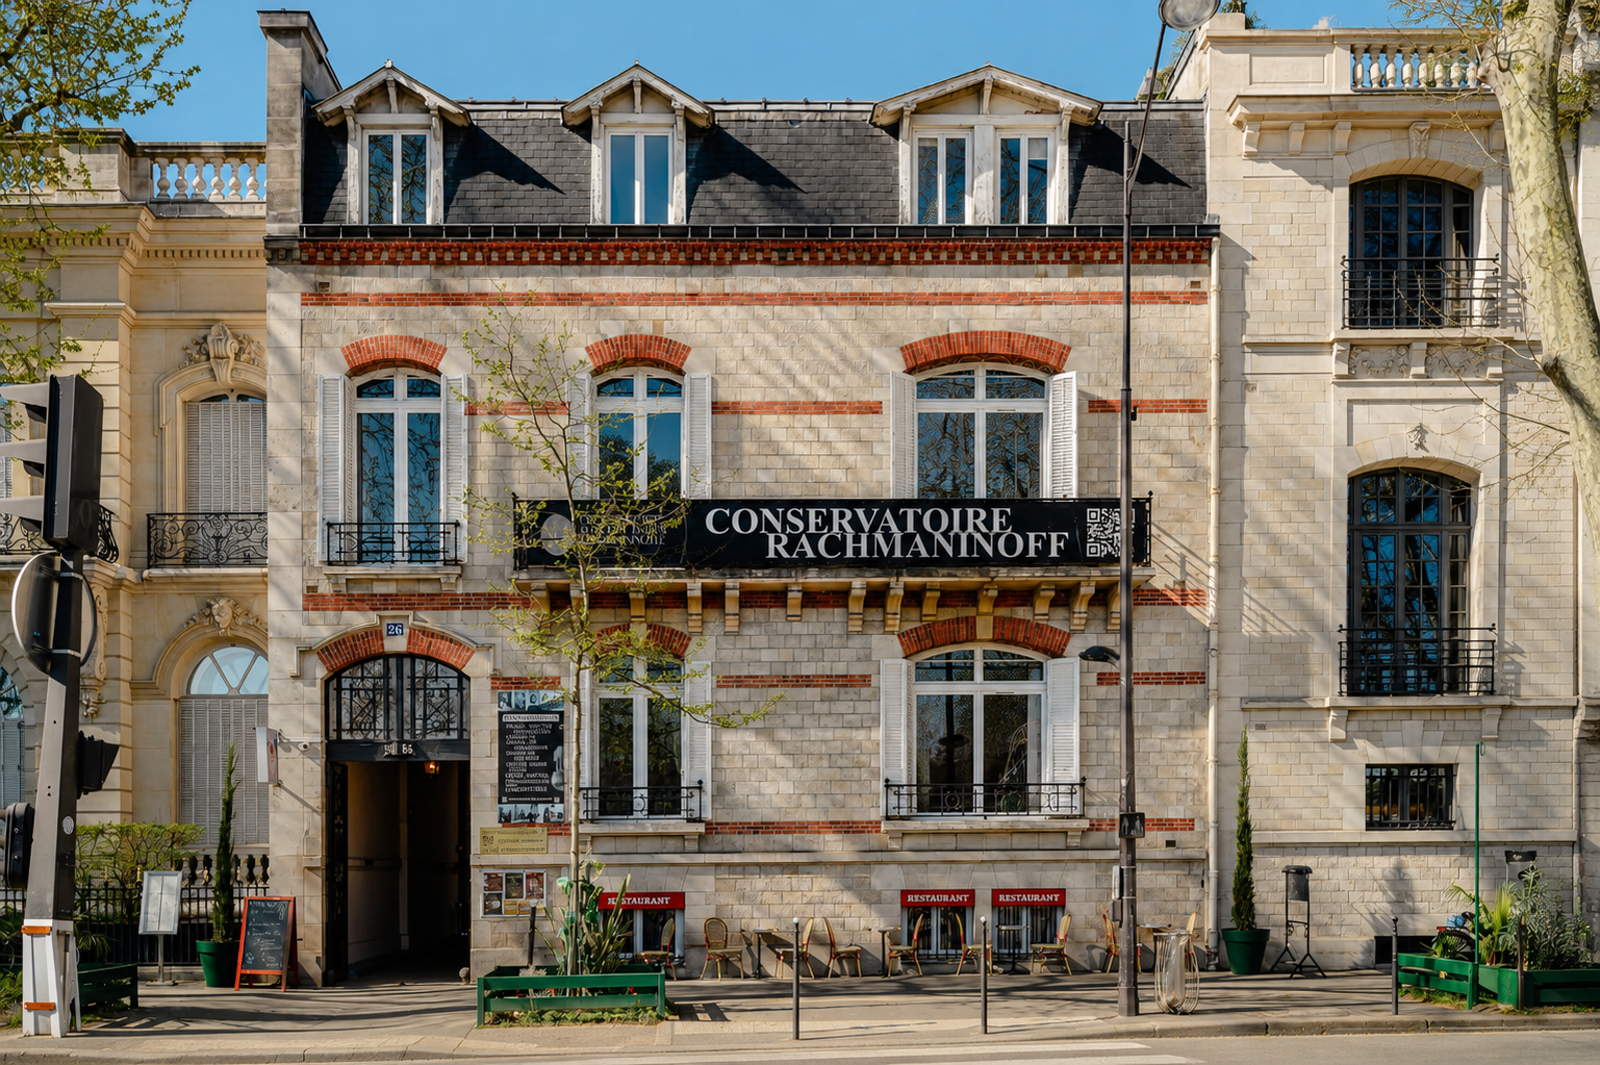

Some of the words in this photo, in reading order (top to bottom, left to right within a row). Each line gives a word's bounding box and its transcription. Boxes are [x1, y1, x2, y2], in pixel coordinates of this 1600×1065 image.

[705, 508, 1012, 534] CONSERVATOIRE
[765, 532, 1069, 558] RACHMANINOFF
[388, 624, 402, 635] 26
[607, 896, 671, 905] RSTAURANT
[907, 894, 969, 902] RESTAURANT
[998, 894, 1060, 902] RESTAURANT
